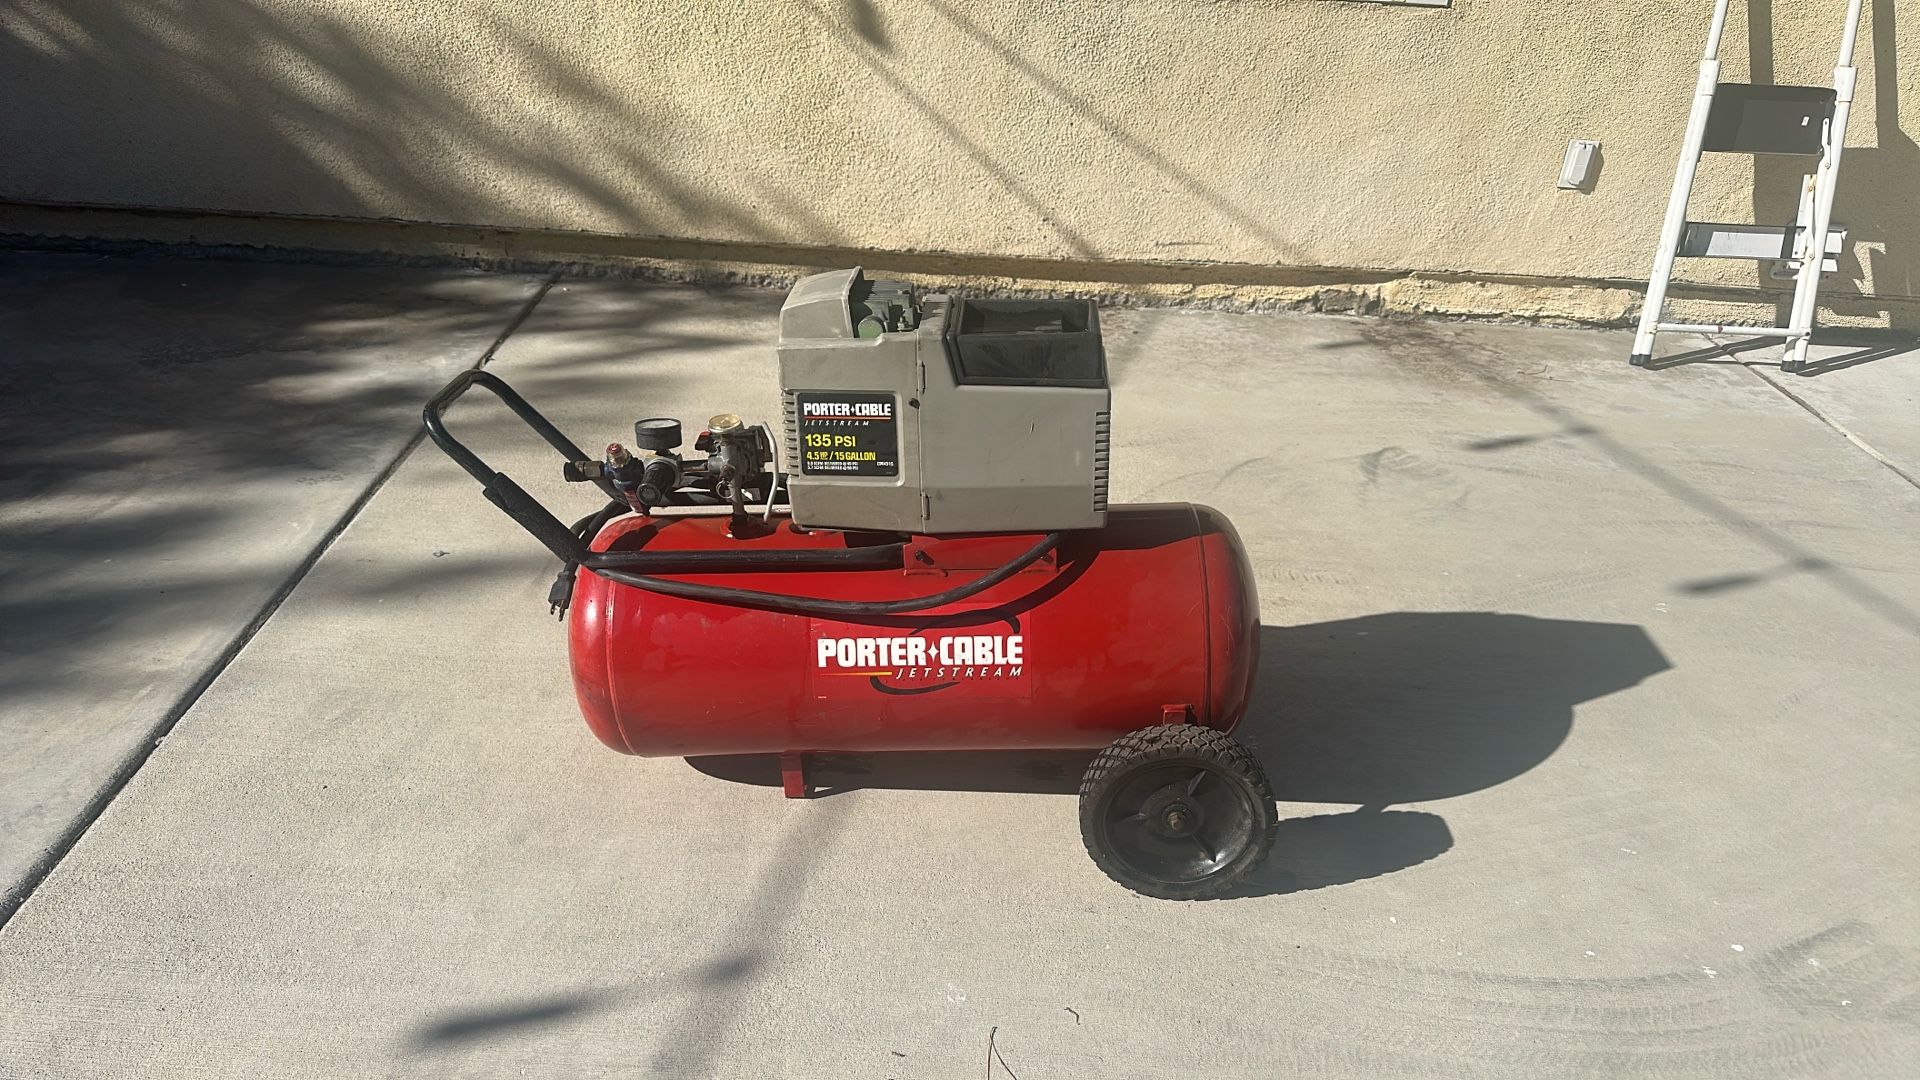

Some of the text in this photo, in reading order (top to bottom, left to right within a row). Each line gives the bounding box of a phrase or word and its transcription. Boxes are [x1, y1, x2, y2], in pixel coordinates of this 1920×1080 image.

[803, 402, 892, 416] PORTER CABLE
[805, 434, 856, 447] 135 PSI
[834, 452, 845, 460] 15
[845, 452, 876, 461] GALLON
[817, 635, 1023, 667] PORTER CABLE
[895, 666, 1023, 680] JETSTREAM
